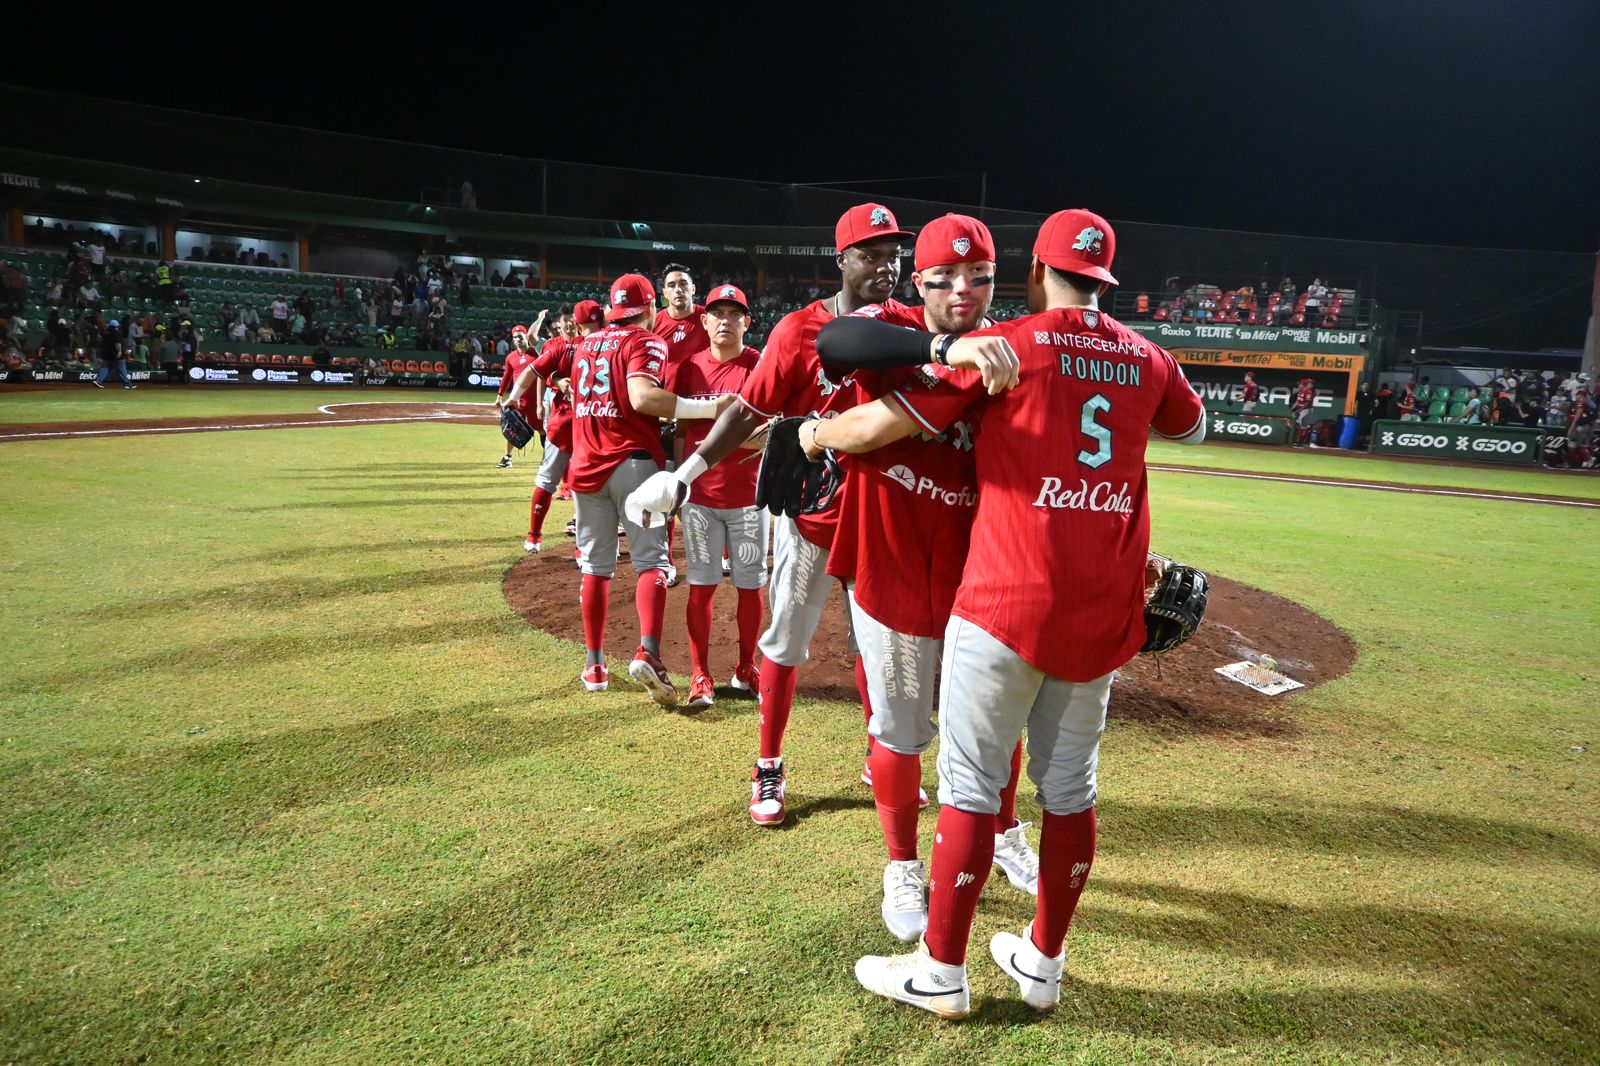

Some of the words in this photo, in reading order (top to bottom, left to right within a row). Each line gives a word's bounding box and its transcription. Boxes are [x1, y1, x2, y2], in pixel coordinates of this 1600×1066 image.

[755, 245, 783, 255] TECATE
[788, 246, 816, 256] TECATE
[820, 246, 838, 256] TECA
[1195, 326, 1234, 339] TECATE
[1251, 331, 1280, 341] Mifel
[1282, 329, 1311, 337] POWER
[1316, 332, 1357, 344] Mobil
[581, 339, 620, 353] FLORES
[1052, 331, 1149, 358] INTERCERAMIC
[1184, 352, 1222, 364] TECATE
[1312, 357, 1354, 369] Mobil
[577, 356, 611, 398] 23
[1060, 353, 1141, 387] RONDON
[1188, 383, 1334, 408] OWERAE
[1077, 392, 1113, 470] 5
[1226, 422, 1273, 438] G500
[1396, 434, 1449, 449] G500
[1471, 438, 1528, 454] G500
[917, 476, 981, 507] Profu
[1031, 476, 1089, 510] Red
[1089, 481, 1131, 514] Cola
